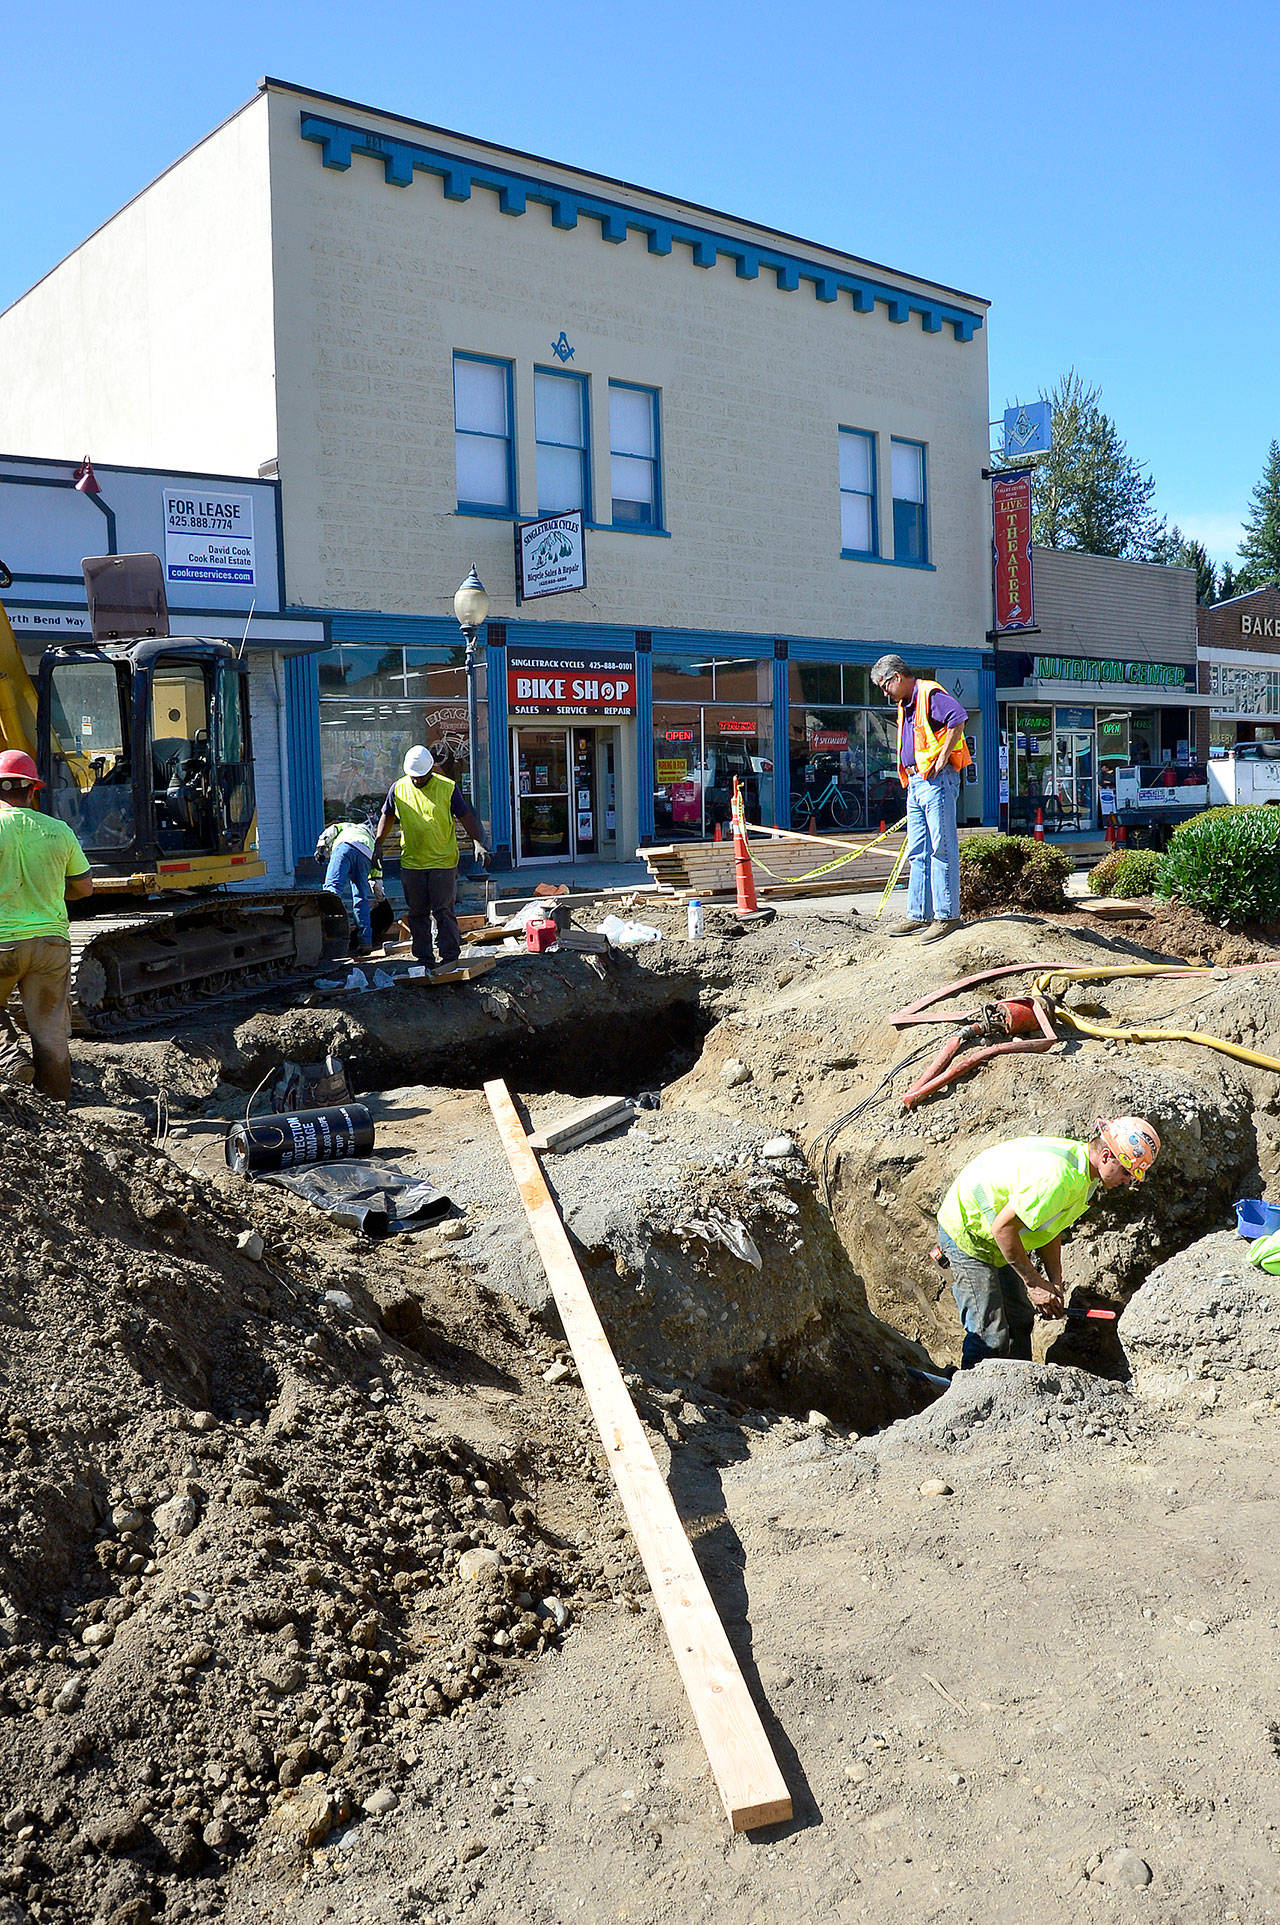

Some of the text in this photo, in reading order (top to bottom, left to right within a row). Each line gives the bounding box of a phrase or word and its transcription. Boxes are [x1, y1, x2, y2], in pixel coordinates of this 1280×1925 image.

[168, 499, 241, 519] FOR LEASE
[1000, 499, 1023, 511] LIVE
[169, 515, 233, 530] 425.888.7774
[208, 545, 251, 556] David Cook
[188, 553, 252, 566] Cook Real Estate
[1006, 513, 1021, 604] THEATER
[171, 568, 251, 581] cookreservices.com
[7, 615, 86, 628] orth Bend Way
[511, 658, 559, 668] SINGLETRACK
[559, 661, 585, 669] CYCLES
[1036, 656, 1186, 687] NUTRITION CENTER
[517, 678, 630, 701] BIKE SHOP
[425, 707, 480, 727] BICYCL
[515, 705, 631, 716] SALES SERVICE REPAIR
[1017, 717, 1051, 728] VITAMINS
[1103, 722, 1121, 735] OPEN
[665, 730, 692, 741] OPEN
